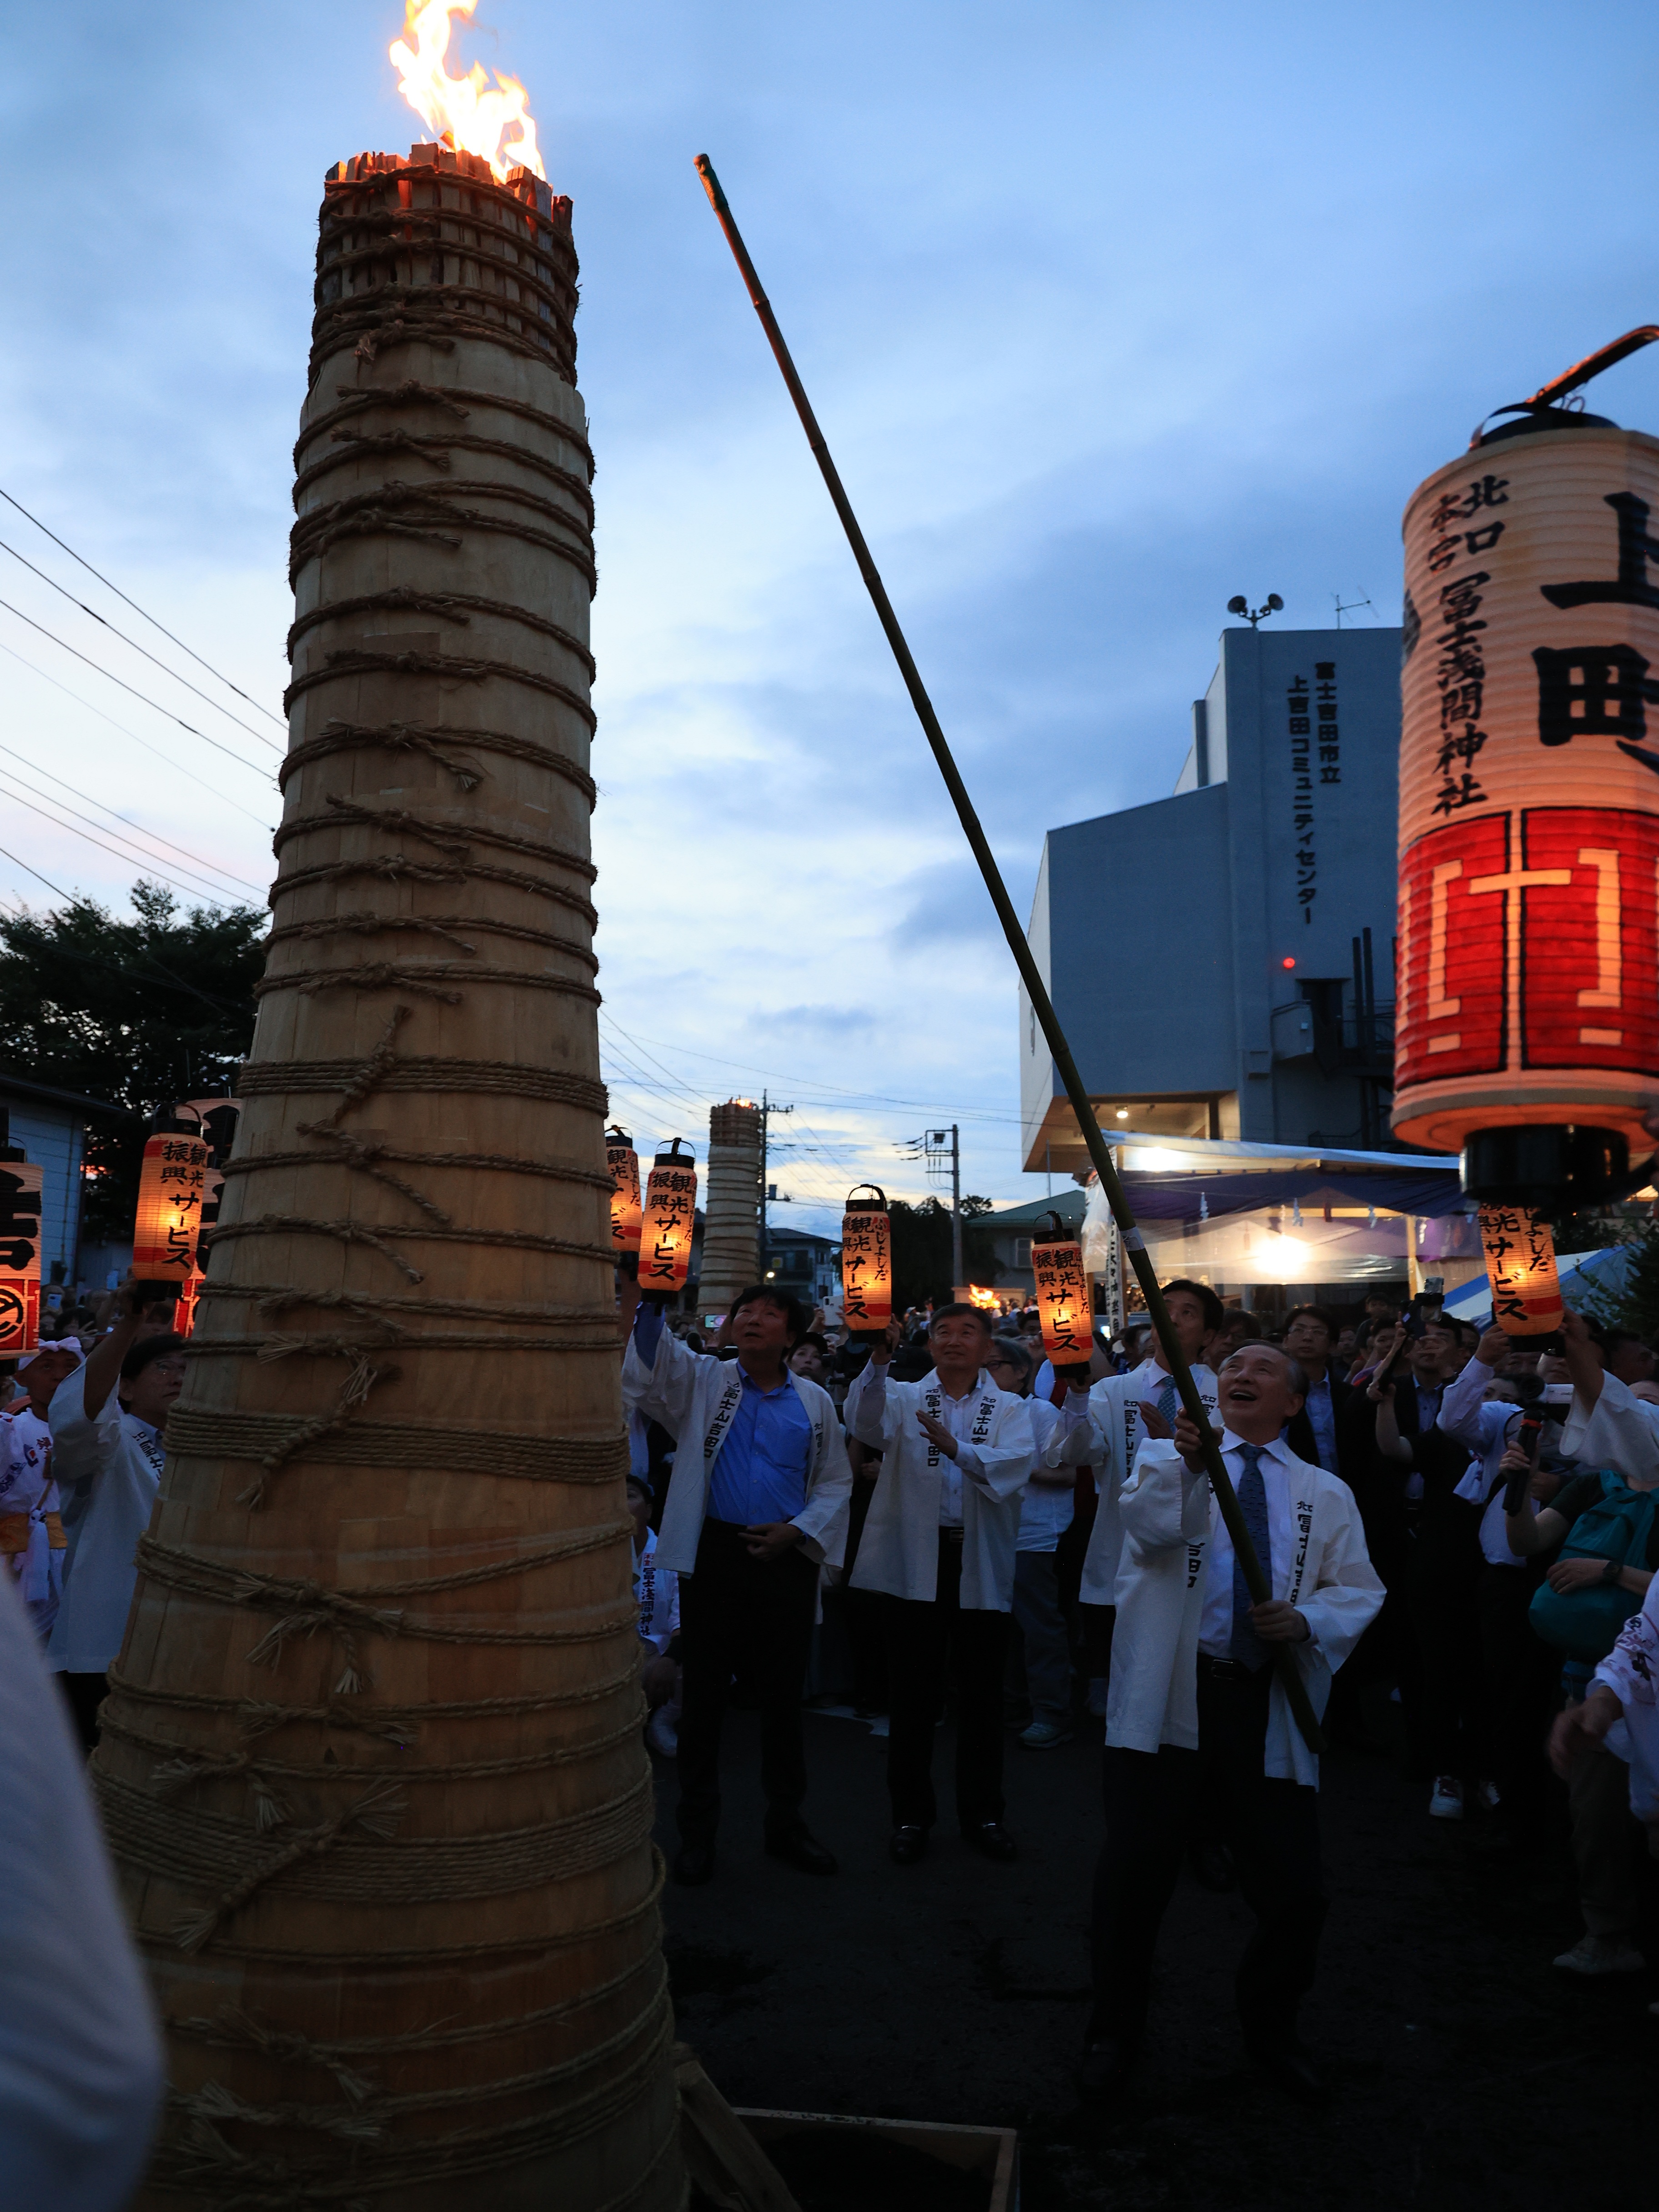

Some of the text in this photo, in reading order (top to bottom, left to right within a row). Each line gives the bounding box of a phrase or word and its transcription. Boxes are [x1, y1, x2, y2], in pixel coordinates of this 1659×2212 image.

[1287, 675, 1317, 925] 上吉田コミュニティセンター
[1314, 662, 1341, 783] 富士吉田市立
